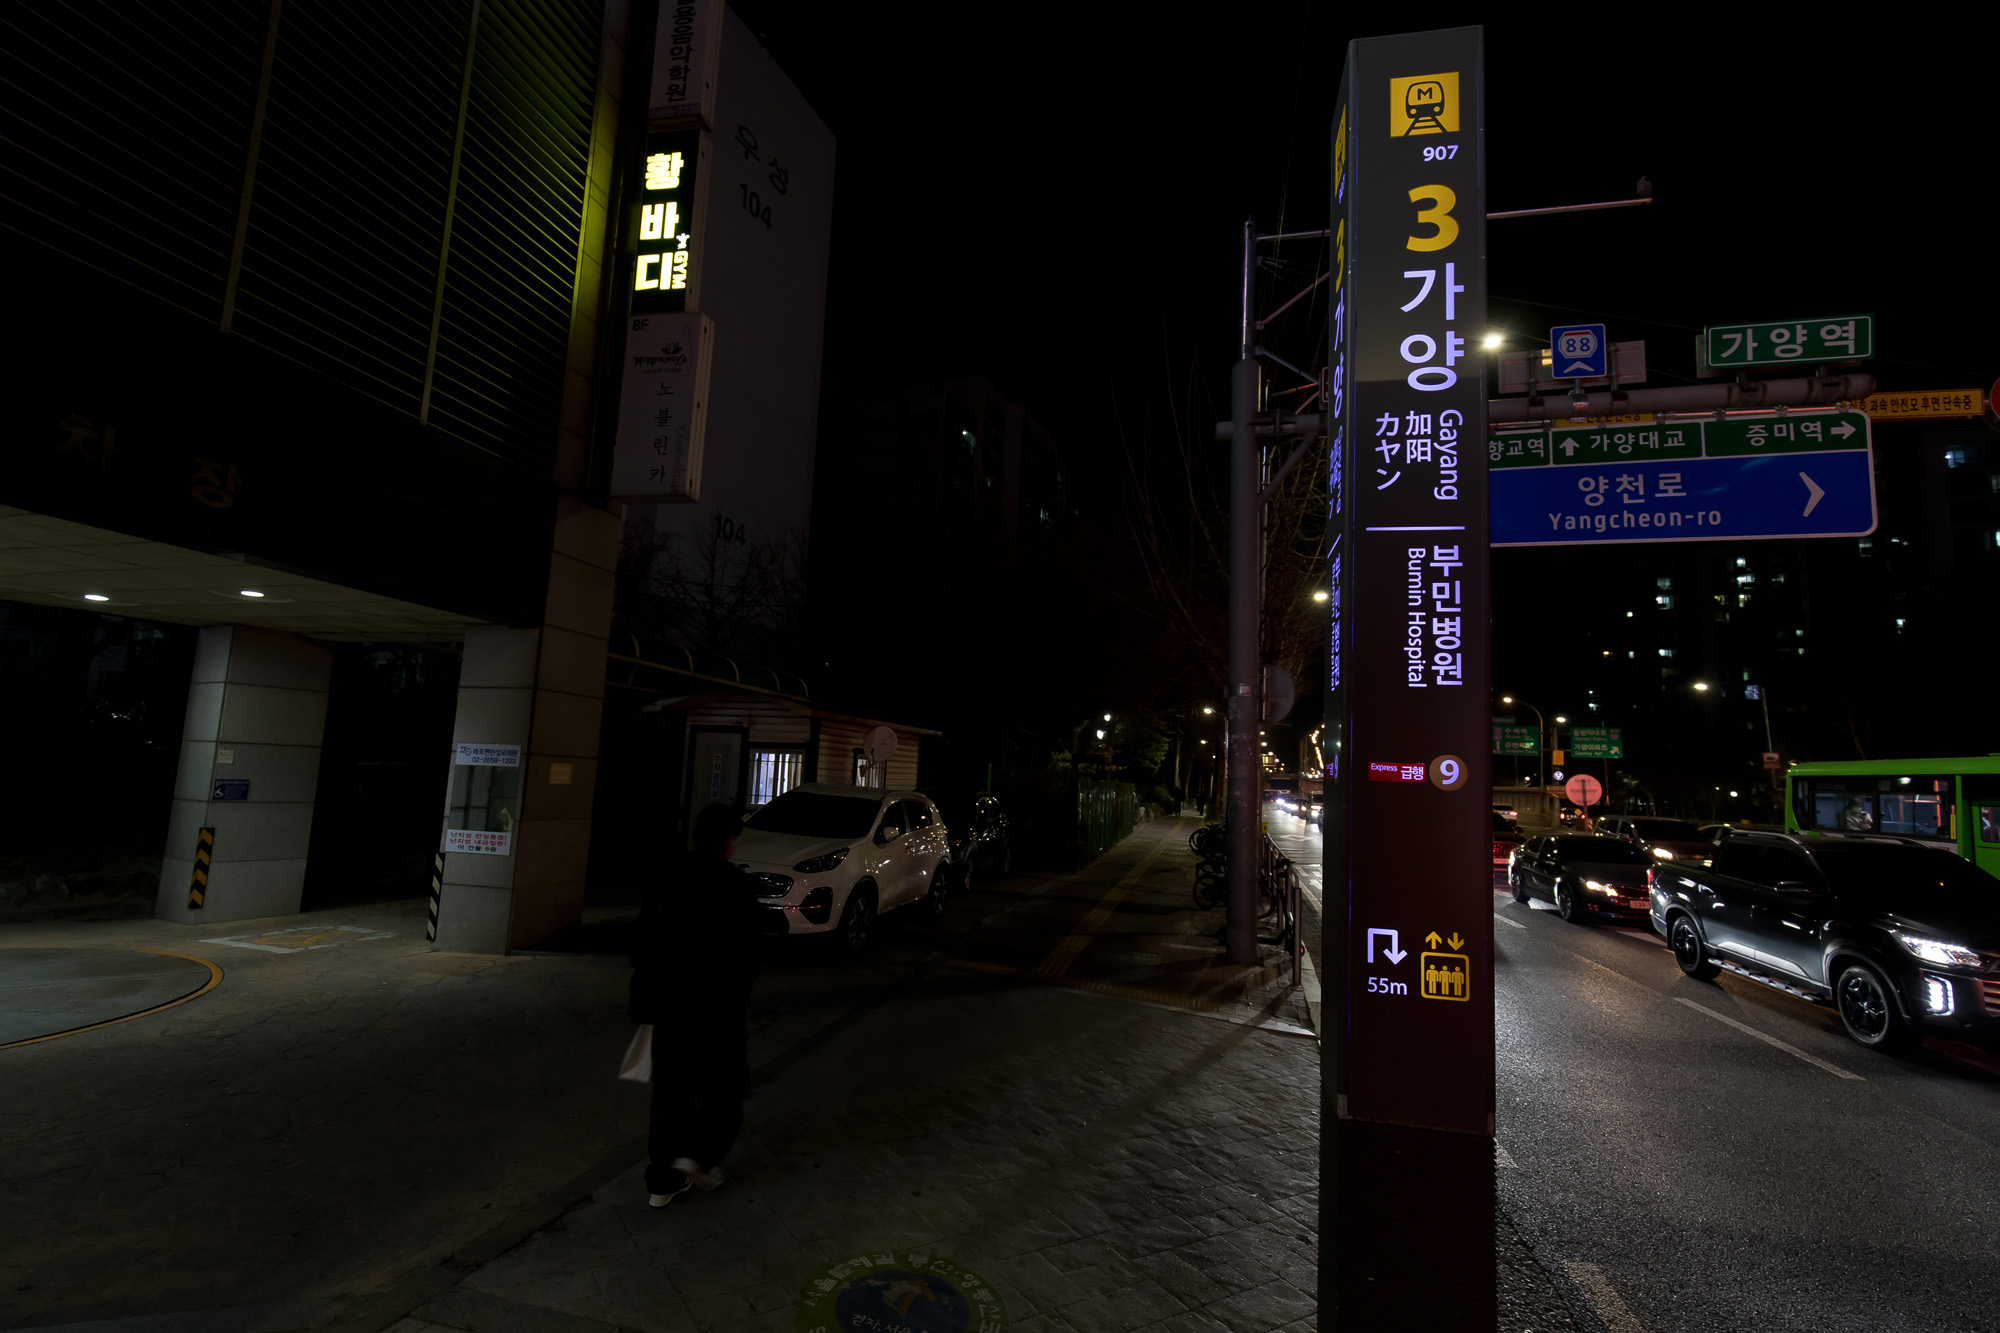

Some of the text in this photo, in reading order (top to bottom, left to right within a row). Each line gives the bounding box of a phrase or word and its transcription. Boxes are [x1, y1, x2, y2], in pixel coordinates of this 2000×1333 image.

[1422, 145, 1459, 161] 907
[635, 152, 684, 291] 황바디
[740, 184, 773, 230] 104
[1406, 184, 1459, 252] 3
[671, 251, 689, 289] GYM
[1400, 262, 1464, 391] 가양
[1720, 321, 1856, 361] 가양역
[1566, 338, 1590, 352] 88
[1405, 410, 1432, 463] 加阳
[1489, 437, 1544, 461] 향교역
[1589, 430, 1685, 454] 가양대교
[1746, 420, 1823, 446] 증미역
[1375, 412, 1401, 491] カヤン
[1434, 409, 1463, 501] Gayang
[1577, 473, 1687, 507] 양천로
[1549, 510, 1722, 533] Yangcheon-ro
[1404, 547, 1427, 688] Bumin Hospital
[1430, 545, 1463, 686] 부민병원
[1370, 763, 1398, 772] Express
[1400, 765, 1424, 780] 급행
[1439, 759, 1460, 785] 9
[1367, 976, 1408, 996] 55m
